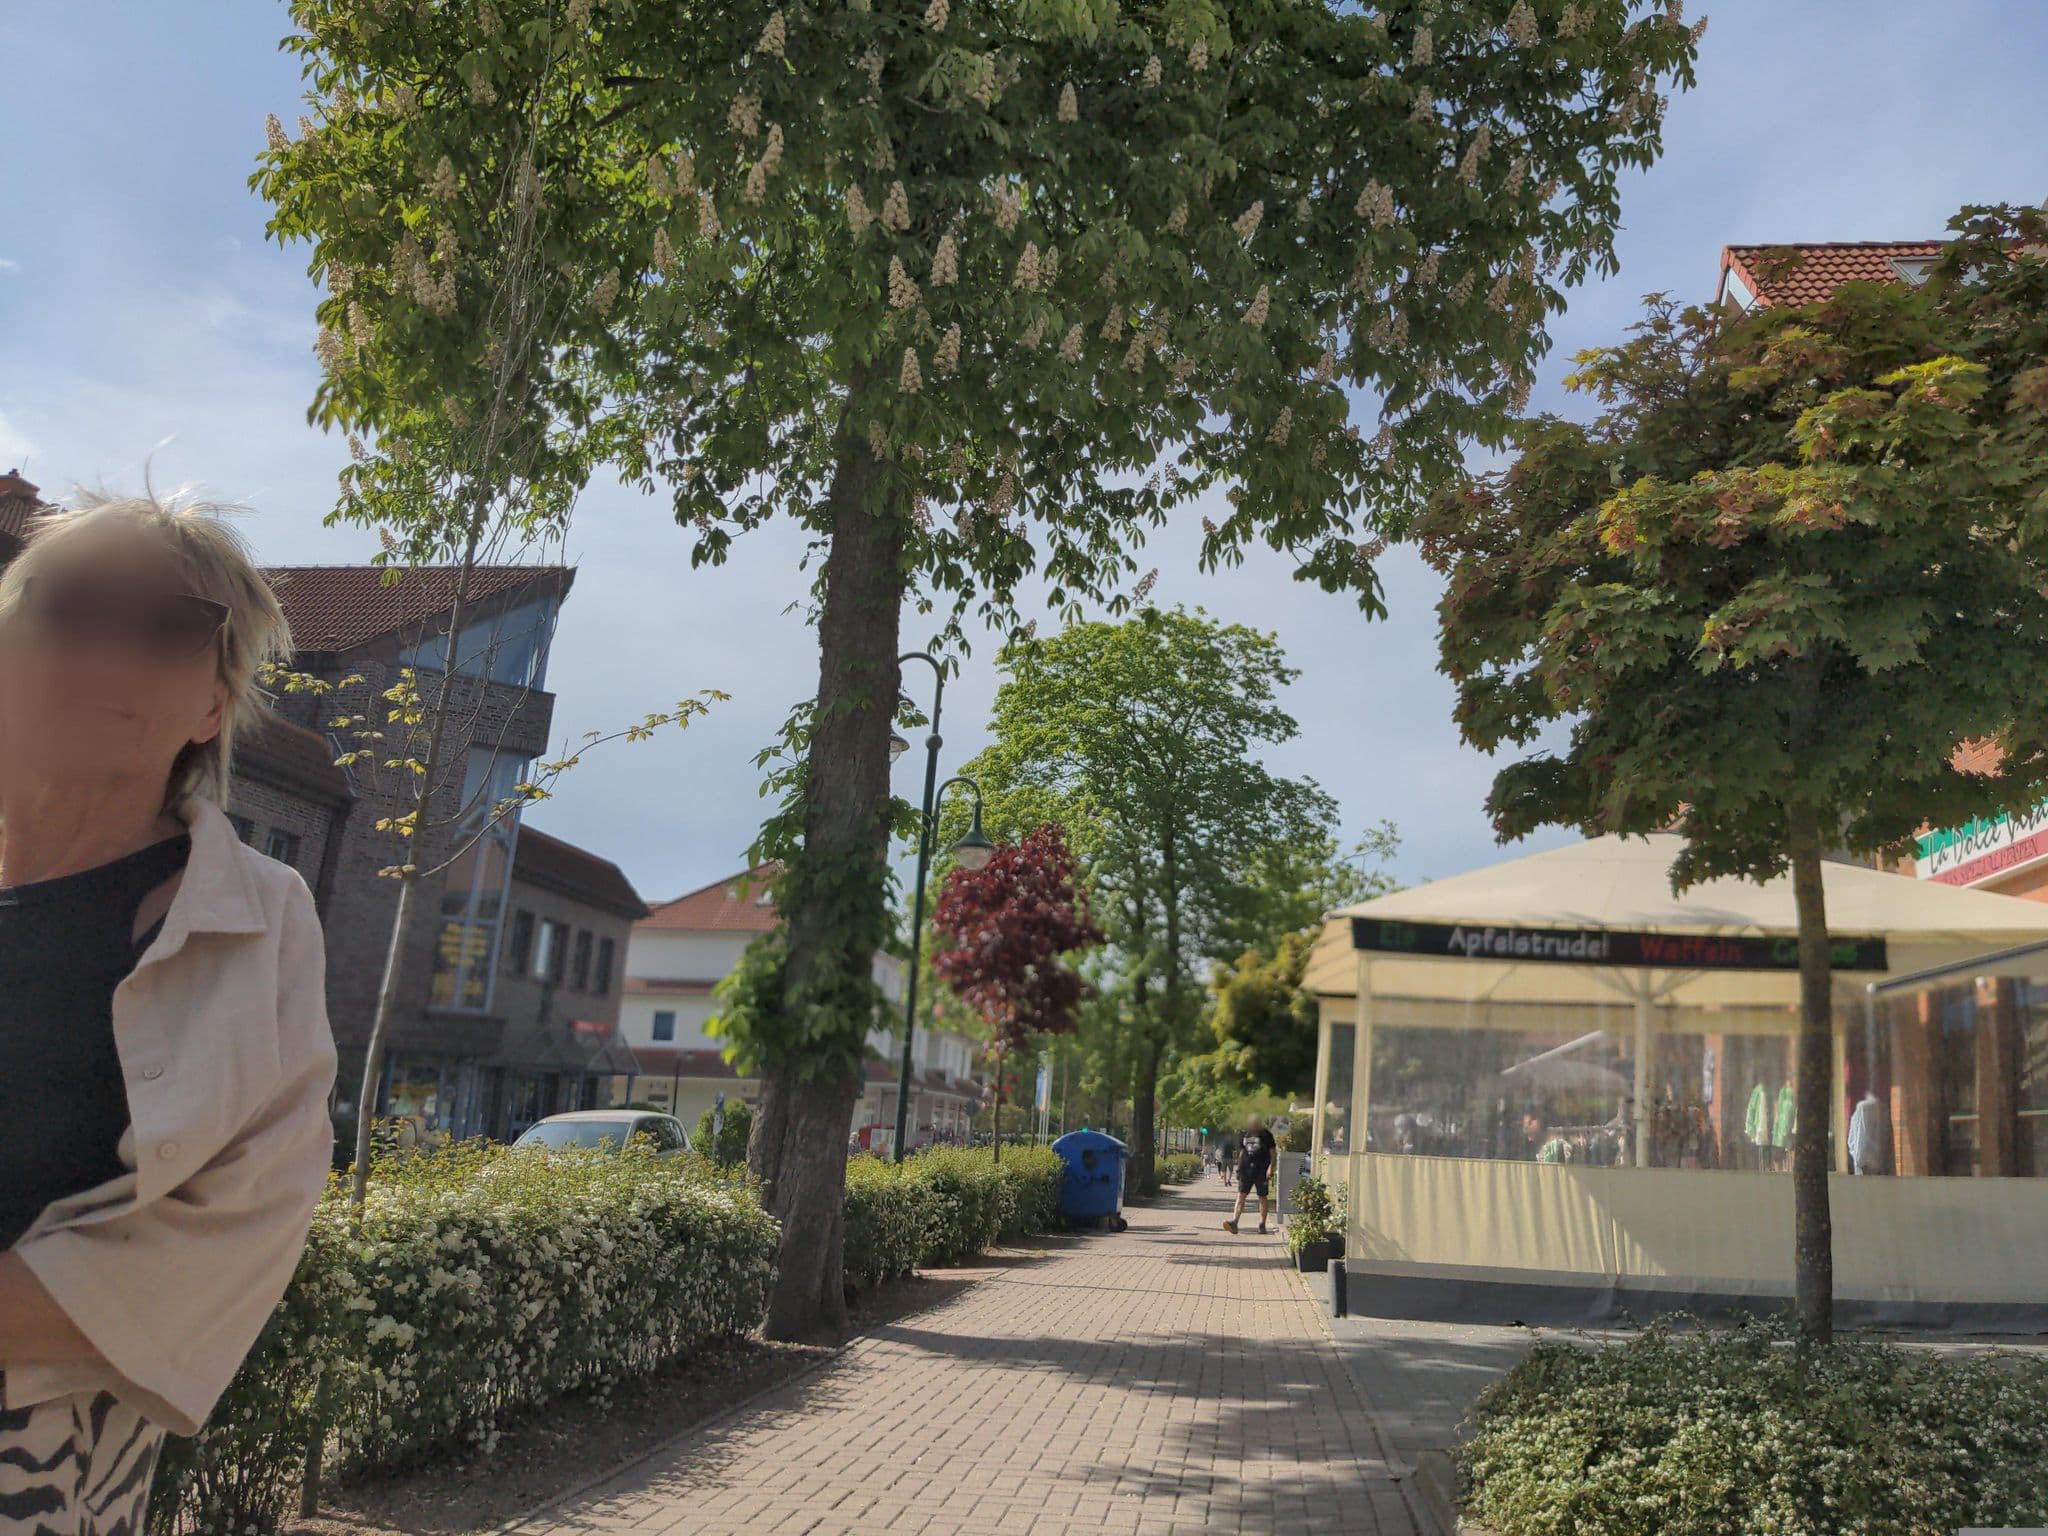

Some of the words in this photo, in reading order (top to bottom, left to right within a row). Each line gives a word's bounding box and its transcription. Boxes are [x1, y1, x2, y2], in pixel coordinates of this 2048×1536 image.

[1928, 834, 1949, 874] La
[1952, 814, 2001, 864] Dolce
[1447, 925, 1610, 958] Apfelstrudel
[1640, 935, 1745, 962] Waffeln
